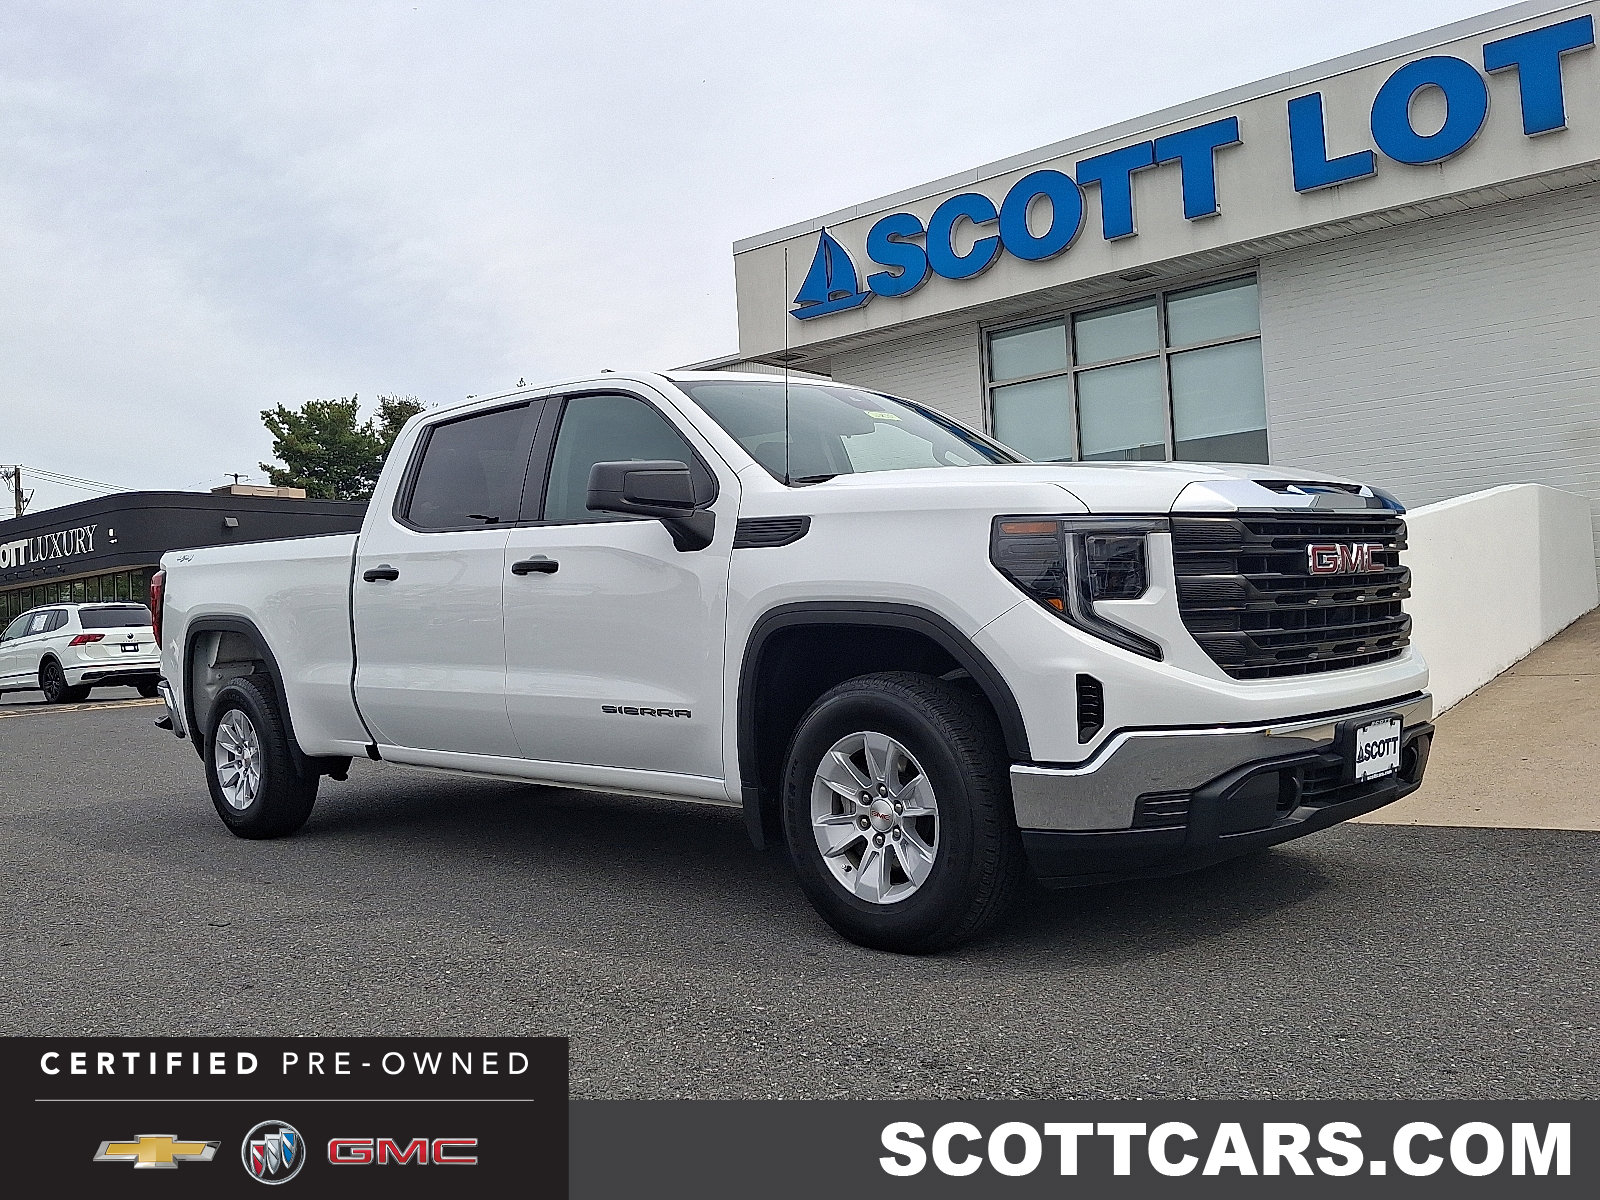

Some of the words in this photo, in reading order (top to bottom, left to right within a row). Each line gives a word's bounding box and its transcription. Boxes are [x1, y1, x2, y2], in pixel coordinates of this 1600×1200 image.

[866, 117, 1240, 297] SCOTT
[1288, 15, 1595, 191] LOT
[28, 524, 98, 563] LUXURY
[1307, 543, 1385, 575] GMC
[601, 705, 692, 719] SIERRA
[1365, 736, 1399, 762] SCOTT
